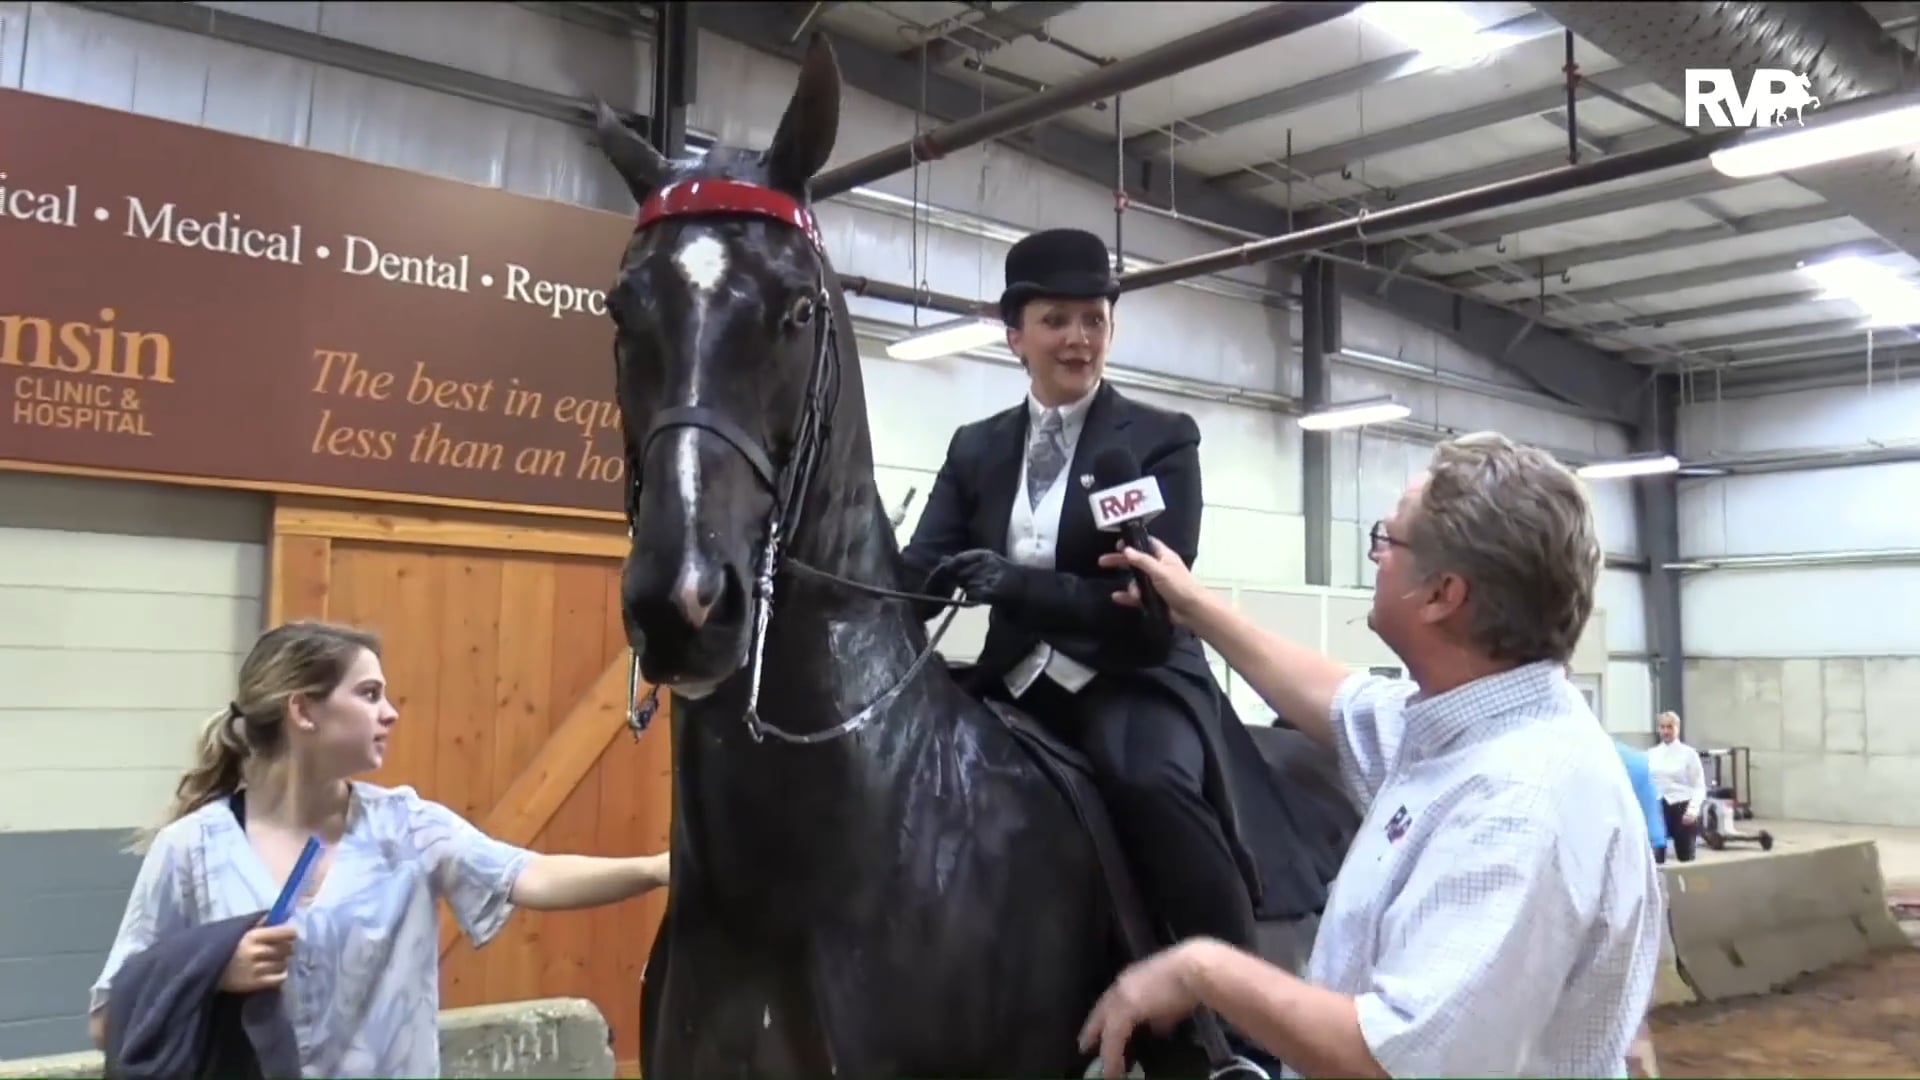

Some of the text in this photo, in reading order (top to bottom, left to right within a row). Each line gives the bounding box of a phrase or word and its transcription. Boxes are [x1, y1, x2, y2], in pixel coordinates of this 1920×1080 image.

[123, 195, 303, 265] Medical
[342, 234, 470, 292] Dental
[15, 376, 140, 410] CLINIC &
[312, 349, 395, 400] The
[406, 361, 494, 412] best
[504, 378, 542, 419] in
[13, 402, 152, 437] HOSPITAL
[312, 410, 397, 461] less
[409, 423, 504, 471] than
[514, 446, 566, 478] an
[1099, 489, 1144, 520] RVP
